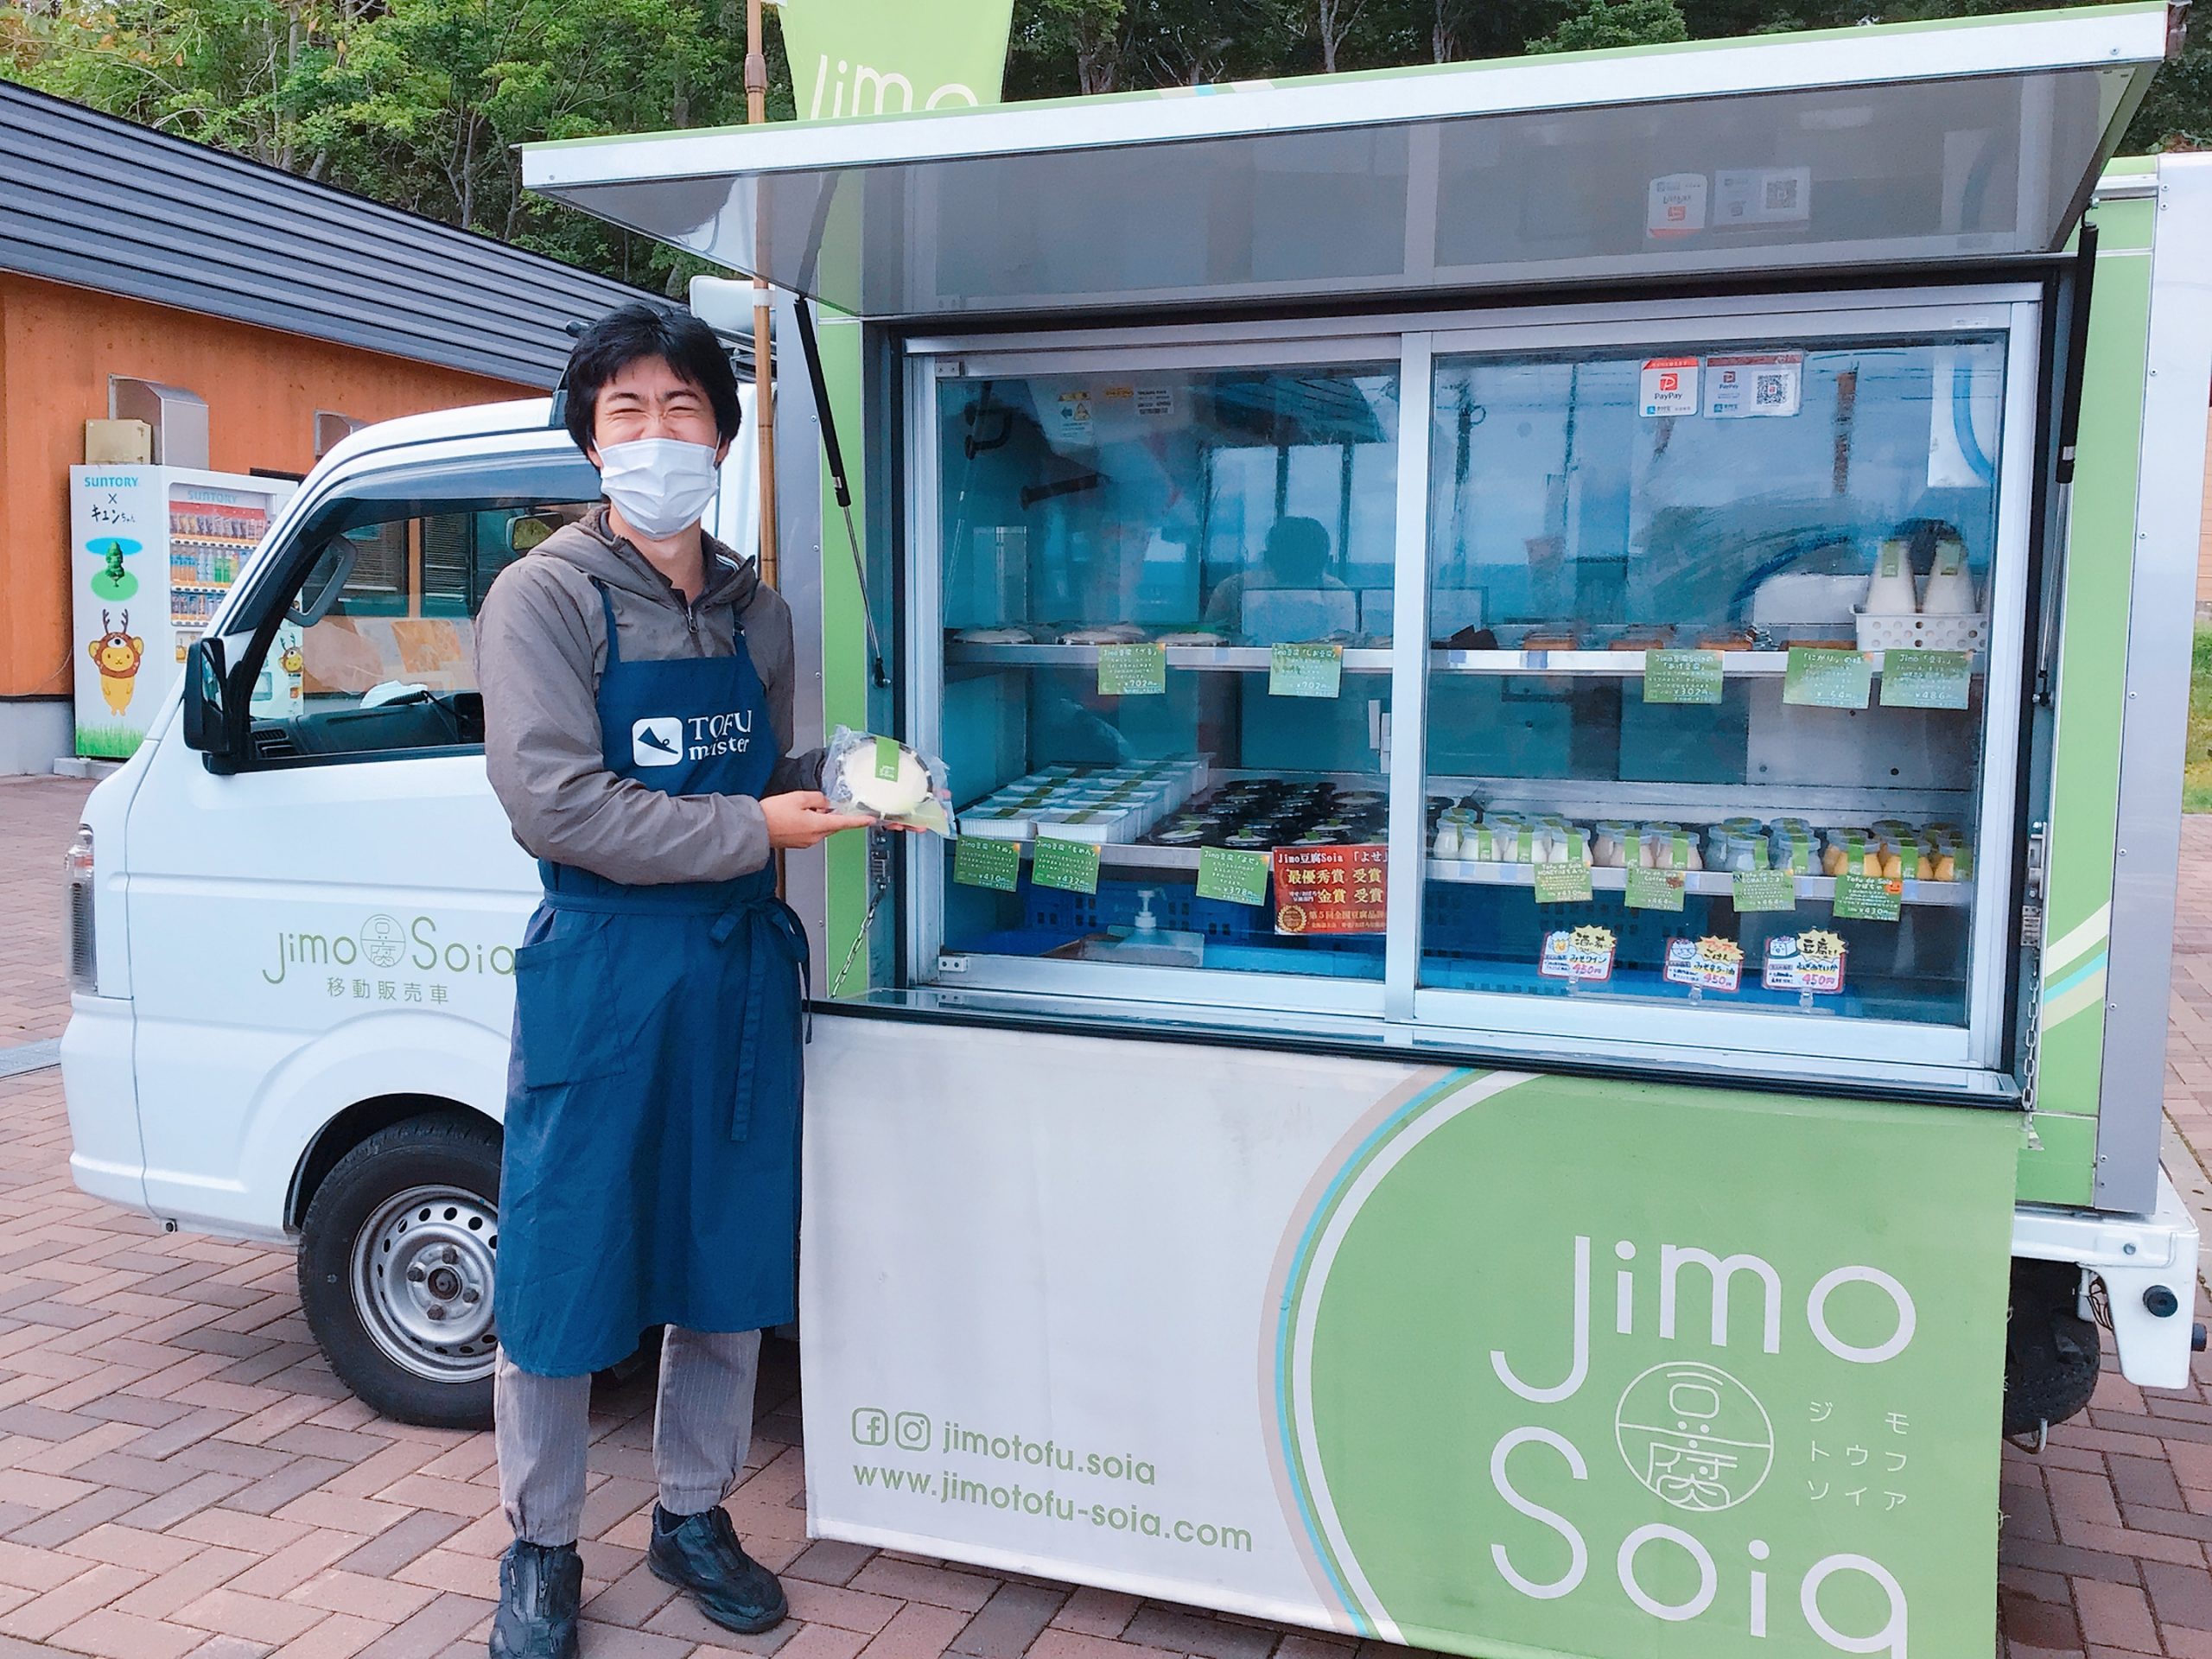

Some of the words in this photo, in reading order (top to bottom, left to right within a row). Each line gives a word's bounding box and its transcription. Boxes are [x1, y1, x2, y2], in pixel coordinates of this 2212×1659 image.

[84, 477, 138, 487] SUNTORY
[188, 490, 238, 503] SUNTORY
[688, 709, 752, 741] TOFU
[1287, 868, 1345, 884] 最優秀賞
[1352, 868, 1382, 884] 受賞
[1318, 888, 1346, 904] 金賞
[1354, 887, 1383, 904] 受賞
[263, 932, 357, 984] Jimo
[411, 916, 516, 976] Soia
[1573, 963, 1602, 974] 450円
[1703, 973, 1732, 986] 450円
[1802, 974, 1835, 985] 450円
[327, 976, 449, 1004] 移動販売車
[1490, 1236, 1917, 1404] Jimo
[943, 1421, 1156, 1485] jimotofu.soia
[852, 1465, 1252, 1553] www.jimotofu-soia.com
[1490, 1426, 1909, 1659] Soia
